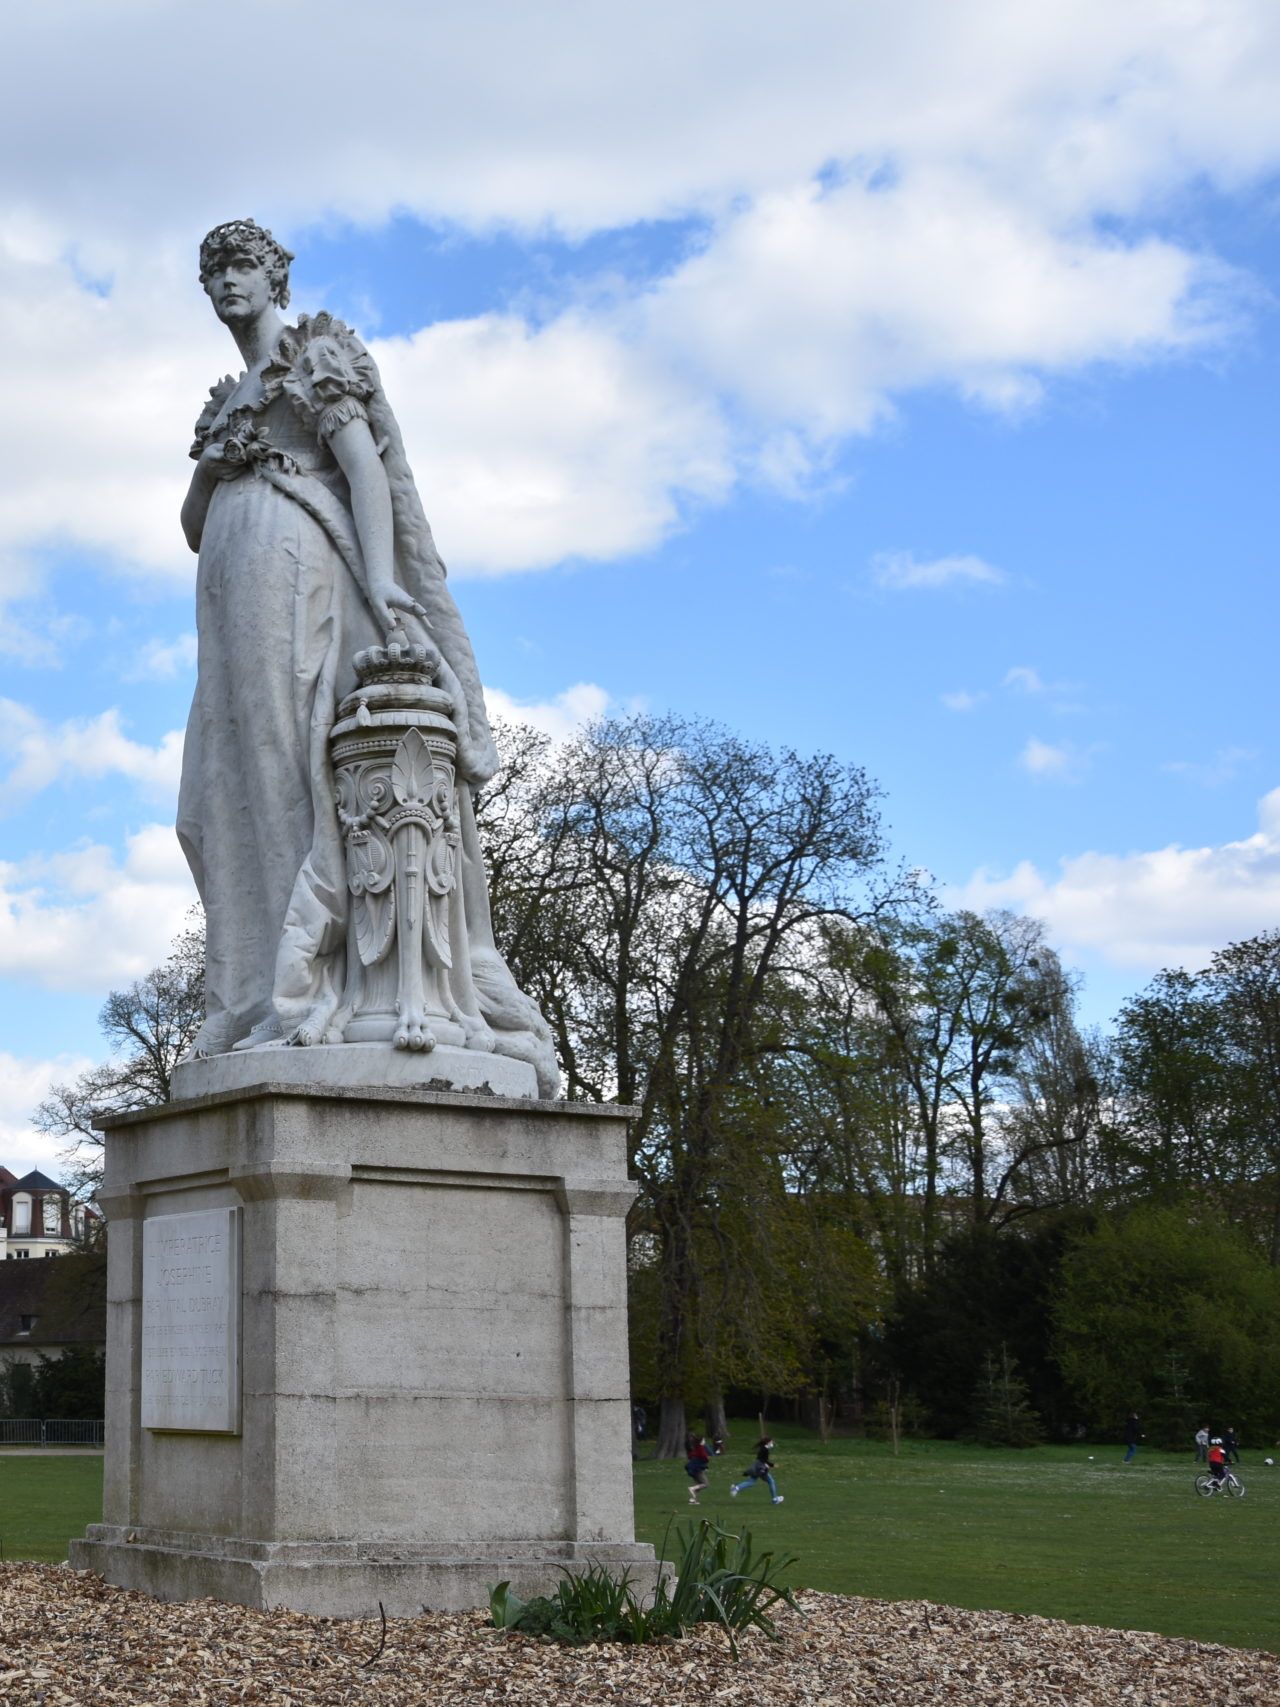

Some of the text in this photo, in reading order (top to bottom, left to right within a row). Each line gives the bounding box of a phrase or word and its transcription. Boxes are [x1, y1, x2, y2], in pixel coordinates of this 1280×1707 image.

[189, 1296, 225, 1312] DUBRAY
[162, 1369, 198, 1384] EDWARD
[199, 1369, 225, 1384] TUCK
